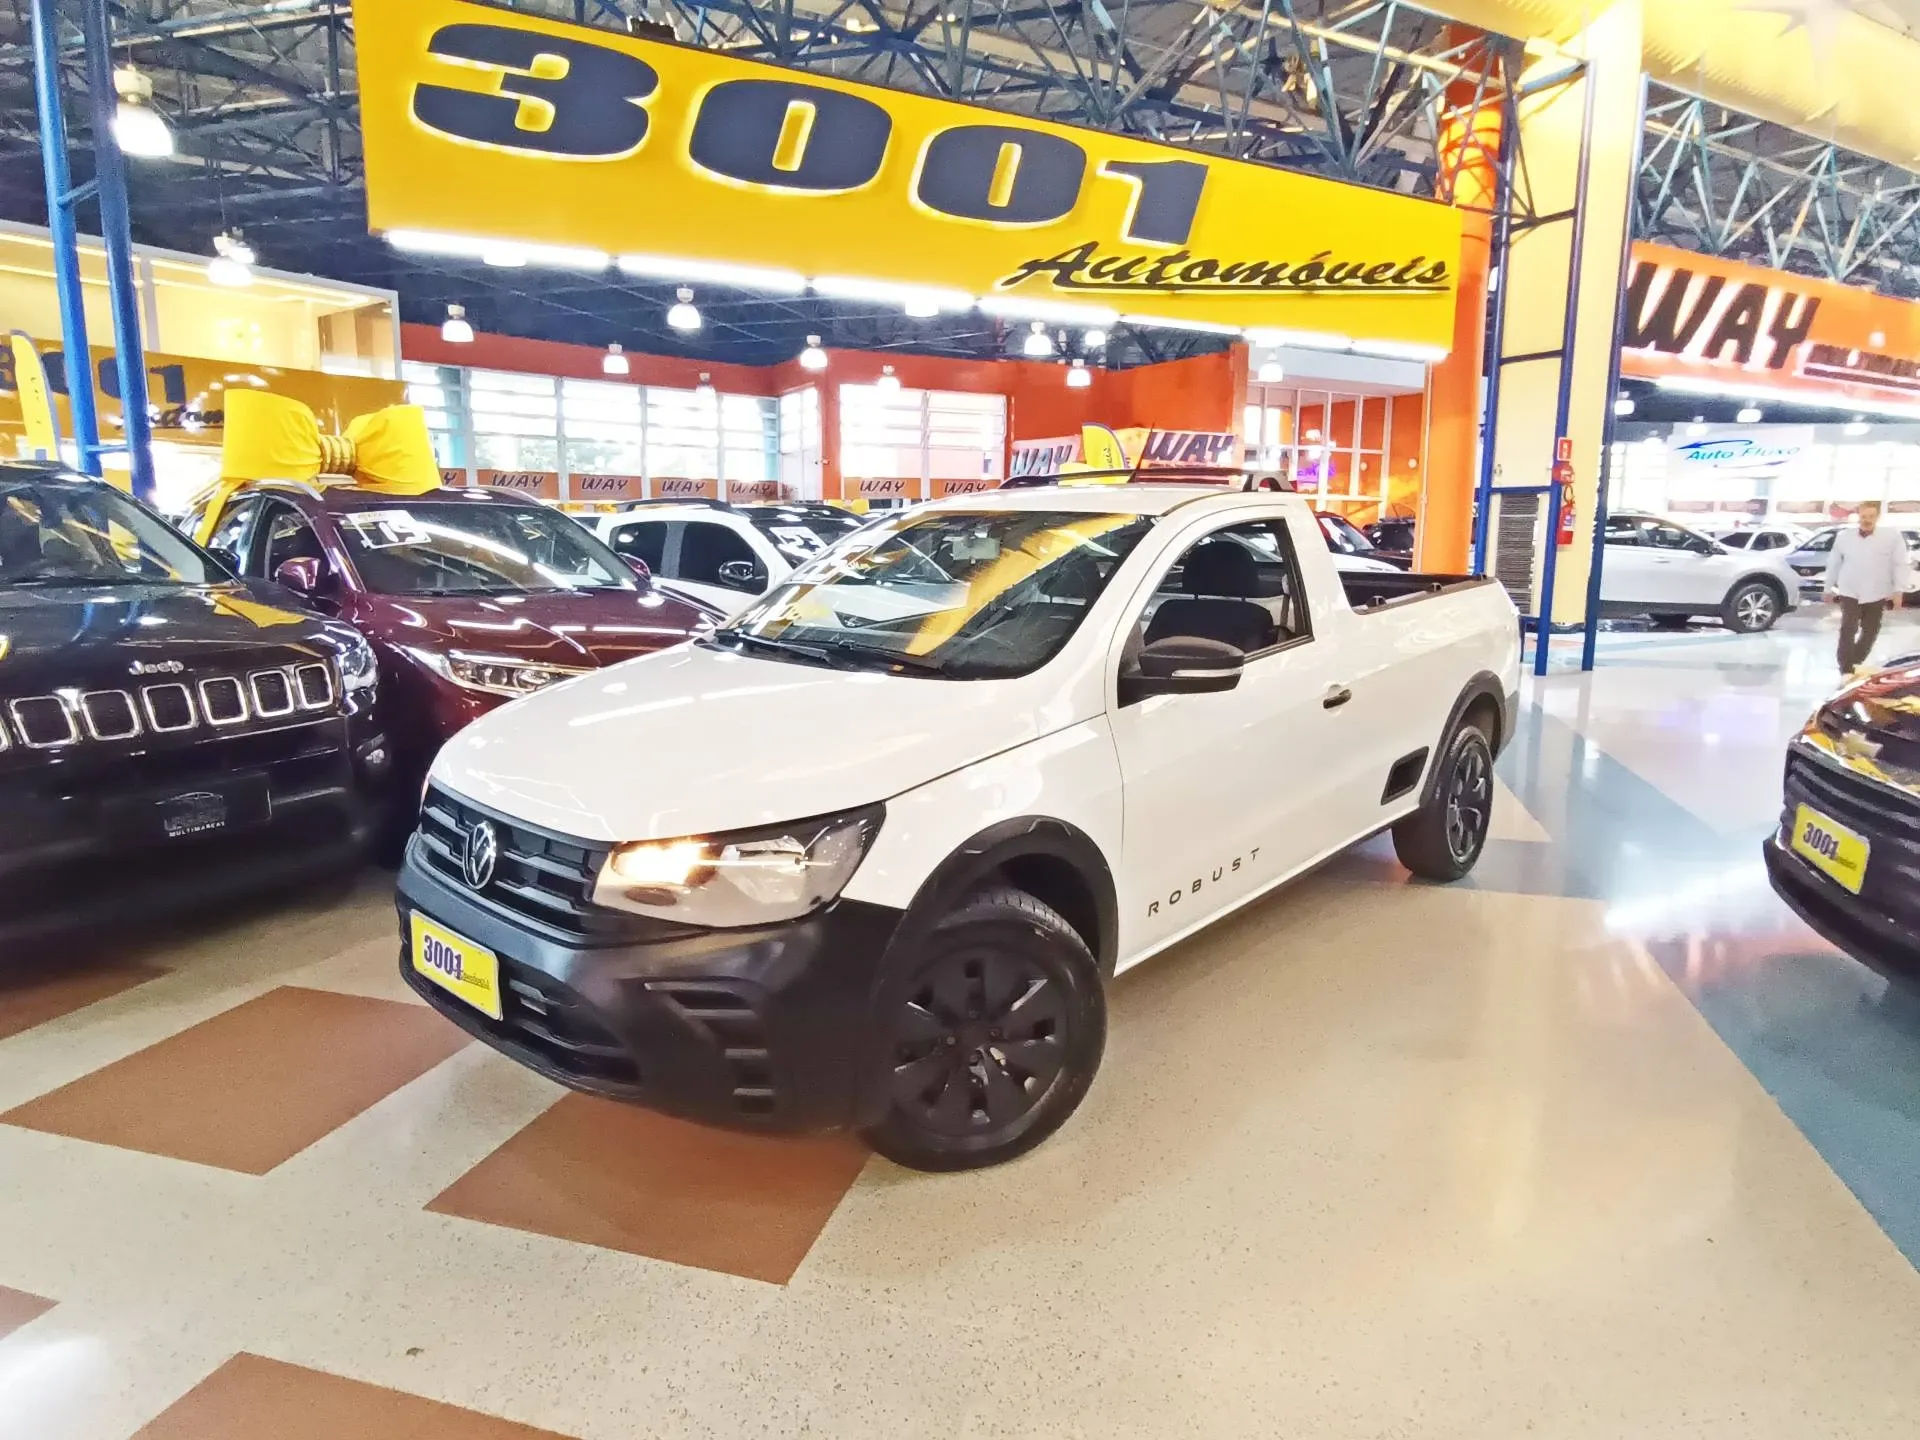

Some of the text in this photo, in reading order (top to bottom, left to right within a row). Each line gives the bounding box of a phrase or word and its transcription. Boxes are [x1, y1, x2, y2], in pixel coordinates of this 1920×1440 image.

[411, 23, 1209, 246] 3001
[1000, 240, 1449, 291] Automóveis
[1621, 261, 1822, 370] WAY
[1147, 431, 1236, 462] WAY
[1686, 449, 1735, 461] Auto
[491, 473, 544, 488] WAY
[581, 477, 629, 491] WAY
[661, 479, 706, 493] WAY
[860, 479, 906, 493] WAY
[943, 481, 987, 494] WAY
[128, 660, 185, 676] Jeep
[1802, 822, 1840, 862] 3001
[1147, 847, 1261, 917] ROBUST
[423, 934, 463, 981] 3001
